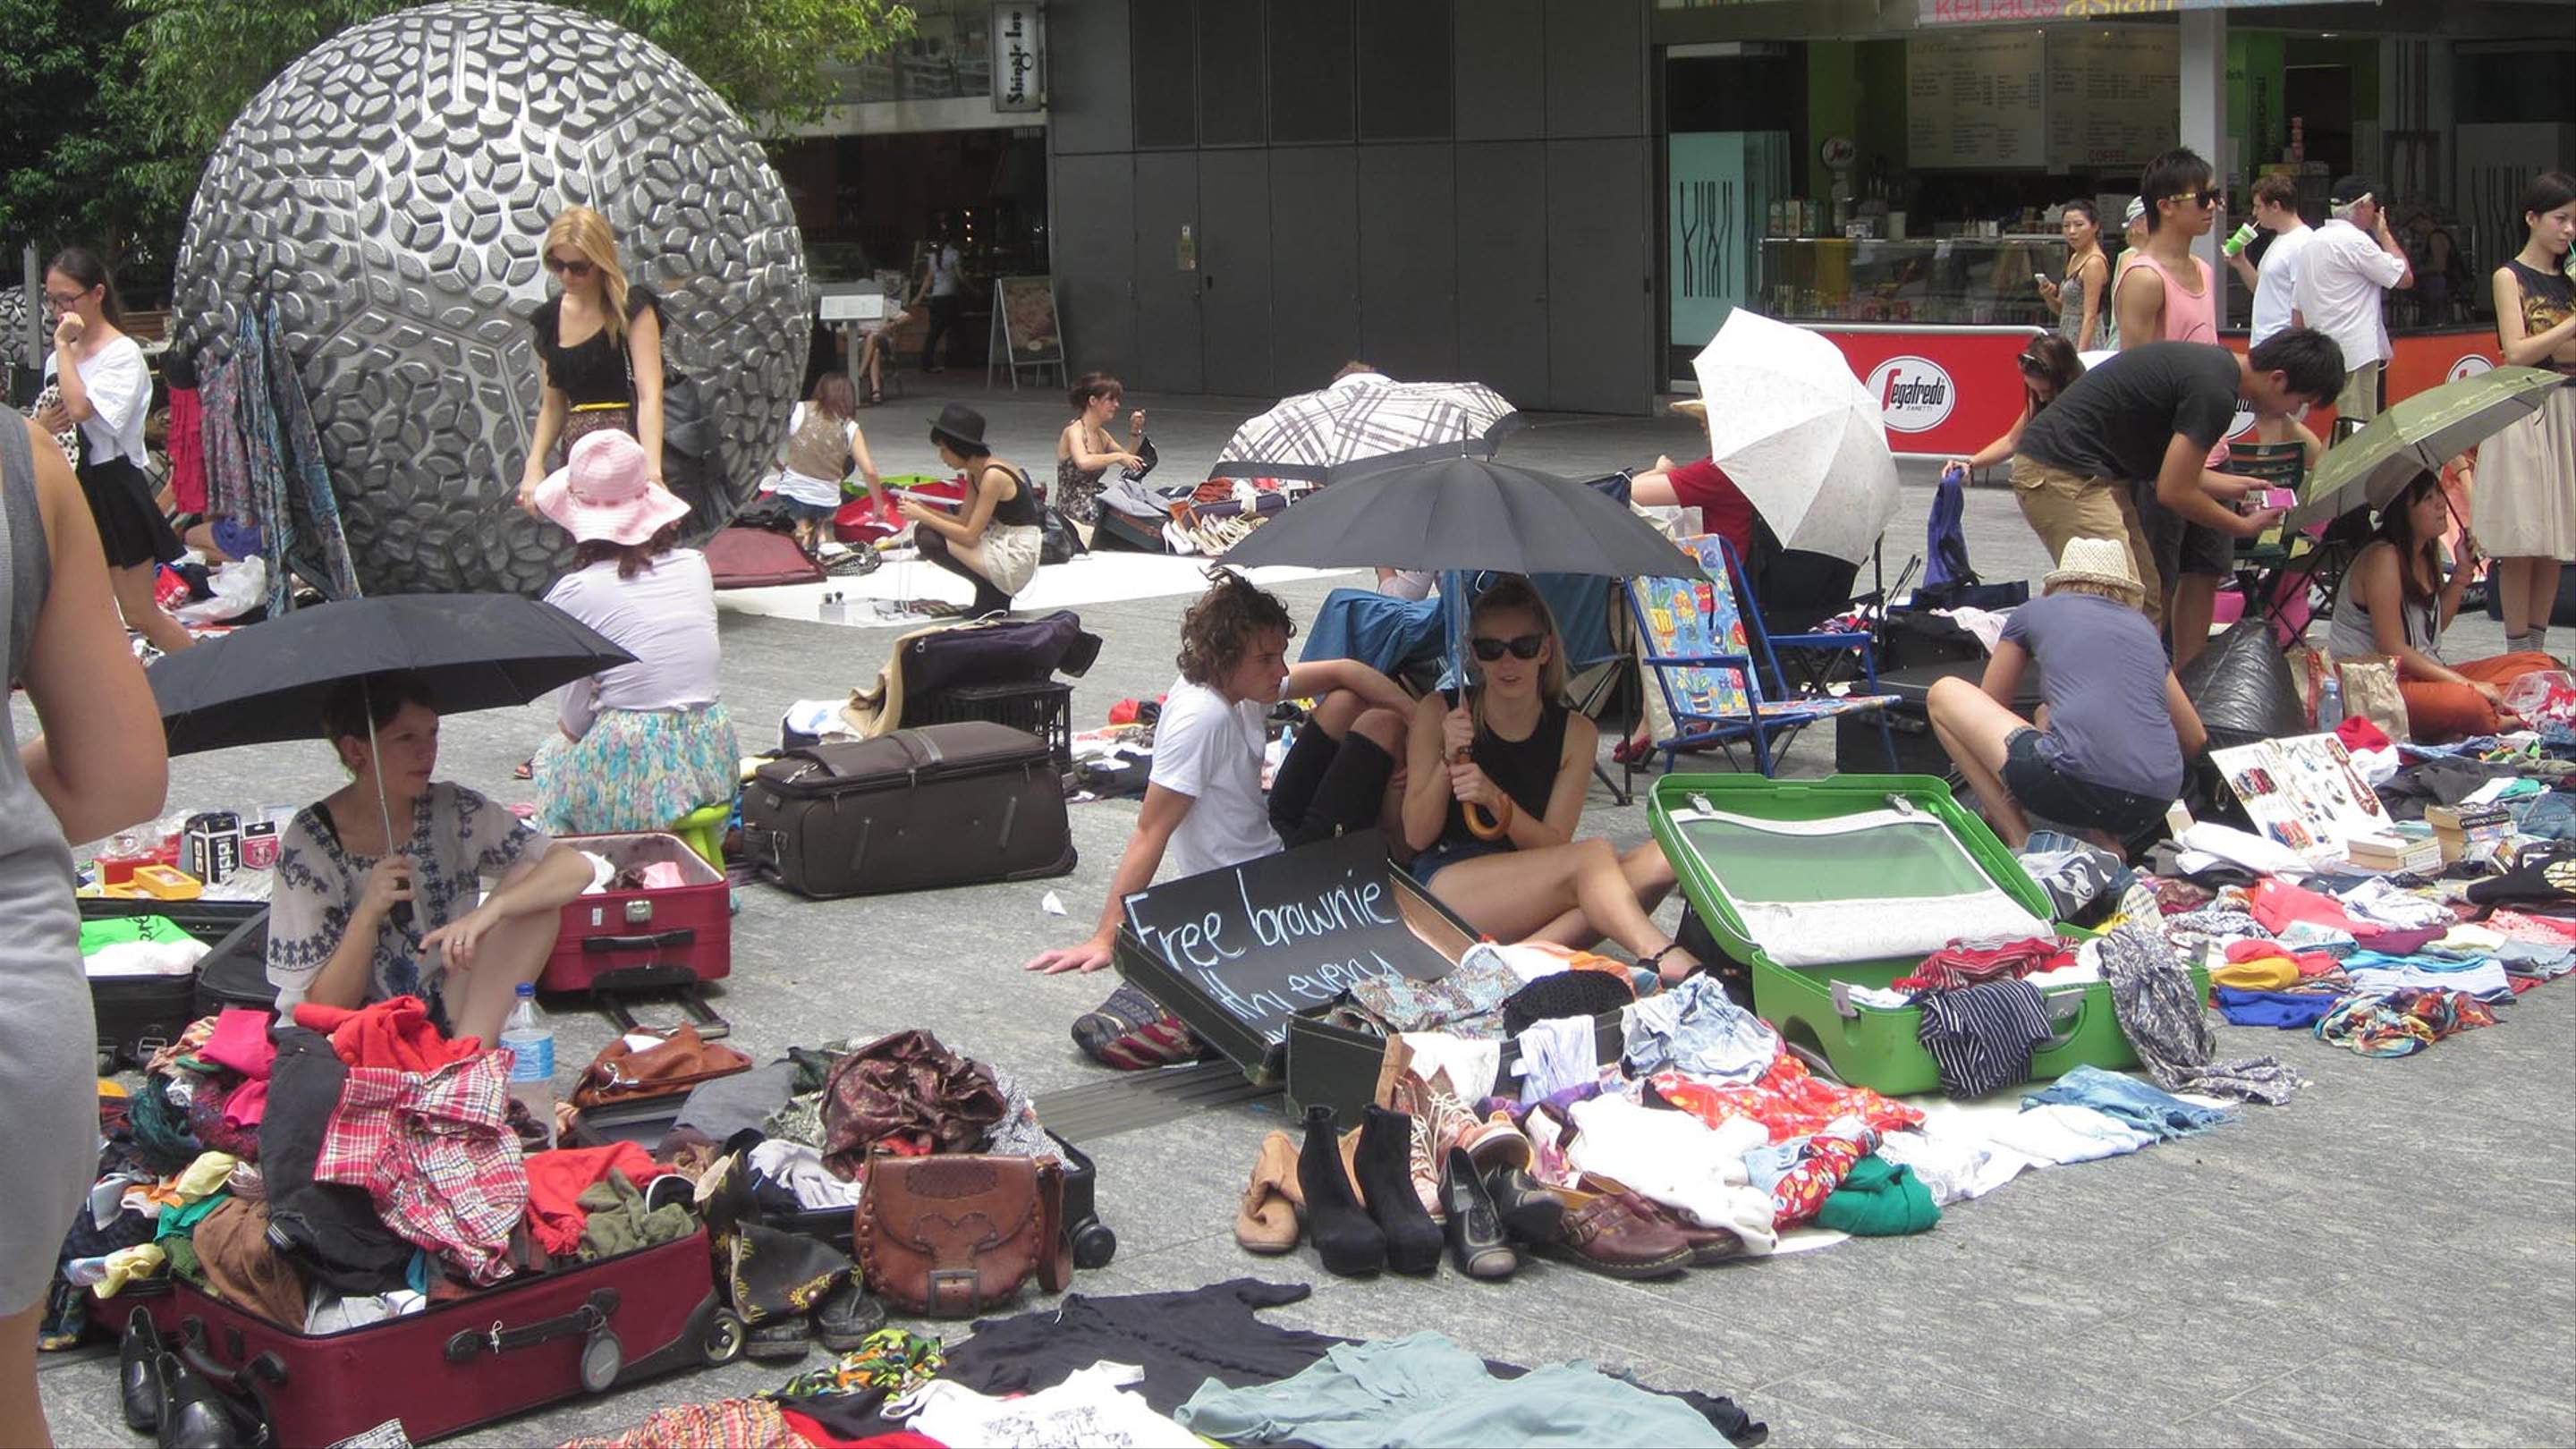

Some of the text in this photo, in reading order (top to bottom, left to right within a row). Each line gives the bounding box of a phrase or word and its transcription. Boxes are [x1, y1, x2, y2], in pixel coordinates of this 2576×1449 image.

[1007, 45, 1033, 104] Shingle
[1882, 368, 1945, 411] Segafredo
[1124, 868, 1399, 972] Free brownie
[1288, 950, 1404, 1000] every
